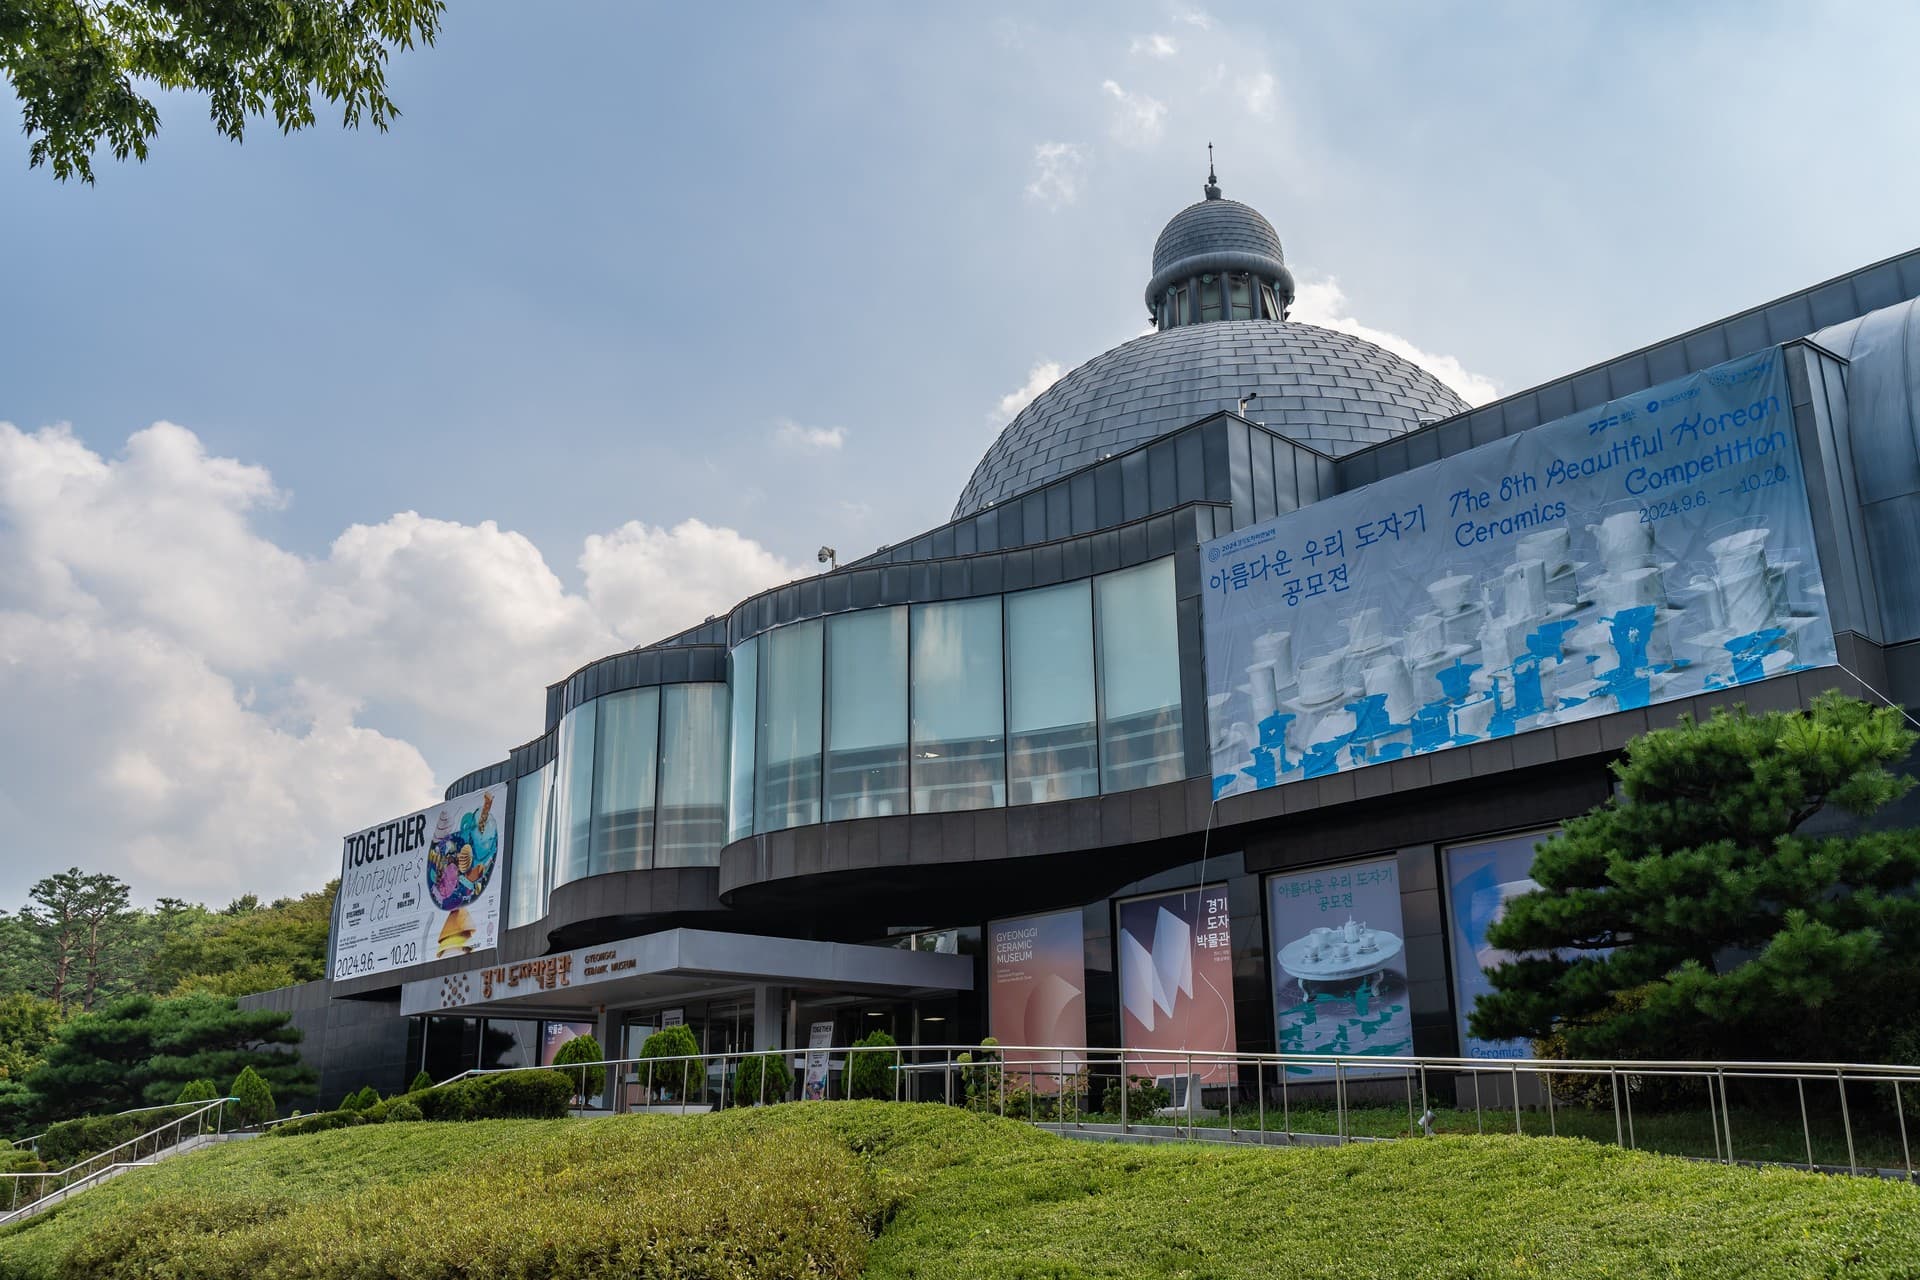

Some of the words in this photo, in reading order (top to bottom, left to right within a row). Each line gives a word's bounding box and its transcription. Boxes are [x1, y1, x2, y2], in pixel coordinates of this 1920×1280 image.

[1450, 486, 1490, 518] The
[1546, 427, 1664, 488] Beautiful
[1670, 394, 1781, 446] Korean
[1625, 430, 1787, 496] Competition
[1639, 490, 1712, 524] 2024.9.6.
[1740, 464, 1791, 493] 10.20.
[1455, 501, 1566, 548] Ceramics
[1209, 549, 1293, 595] 아름다운
[1301, 528, 1346, 568] 우리
[1354, 503, 1427, 550] 도자기
[1281, 562, 1351, 607] 공모전
[347, 813, 427, 870] TOGETHER
[344, 853, 424, 898] Montaigne's
[1278, 879, 1324, 898] 아름다운
[1328, 872, 1352, 890] 우리
[1356, 866, 1393, 886] 도자기
[369, 889, 394, 922] Cat
[1206, 898, 1228, 913] 경기
[1318, 893, 1354, 912] 공모전
[996, 927, 1038, 943] GYEONGGI
[1206, 916, 1230, 930] 도자
[996, 940, 1032, 954] CERAMIC
[1196, 932, 1231, 949] 박물관
[335, 951, 375, 978] 2024.9.6.
[390, 942, 418, 966] 10.20.
[584, 950, 617, 964] GYEONGGI
[610, 959, 637, 972] MUSEUM
[996, 951, 1033, 964] MUSEUM
[480, 967, 506, 998] 경기
[507, 954, 572, 989] 도자박물관
[1470, 1047, 1524, 1059] Ceramics
